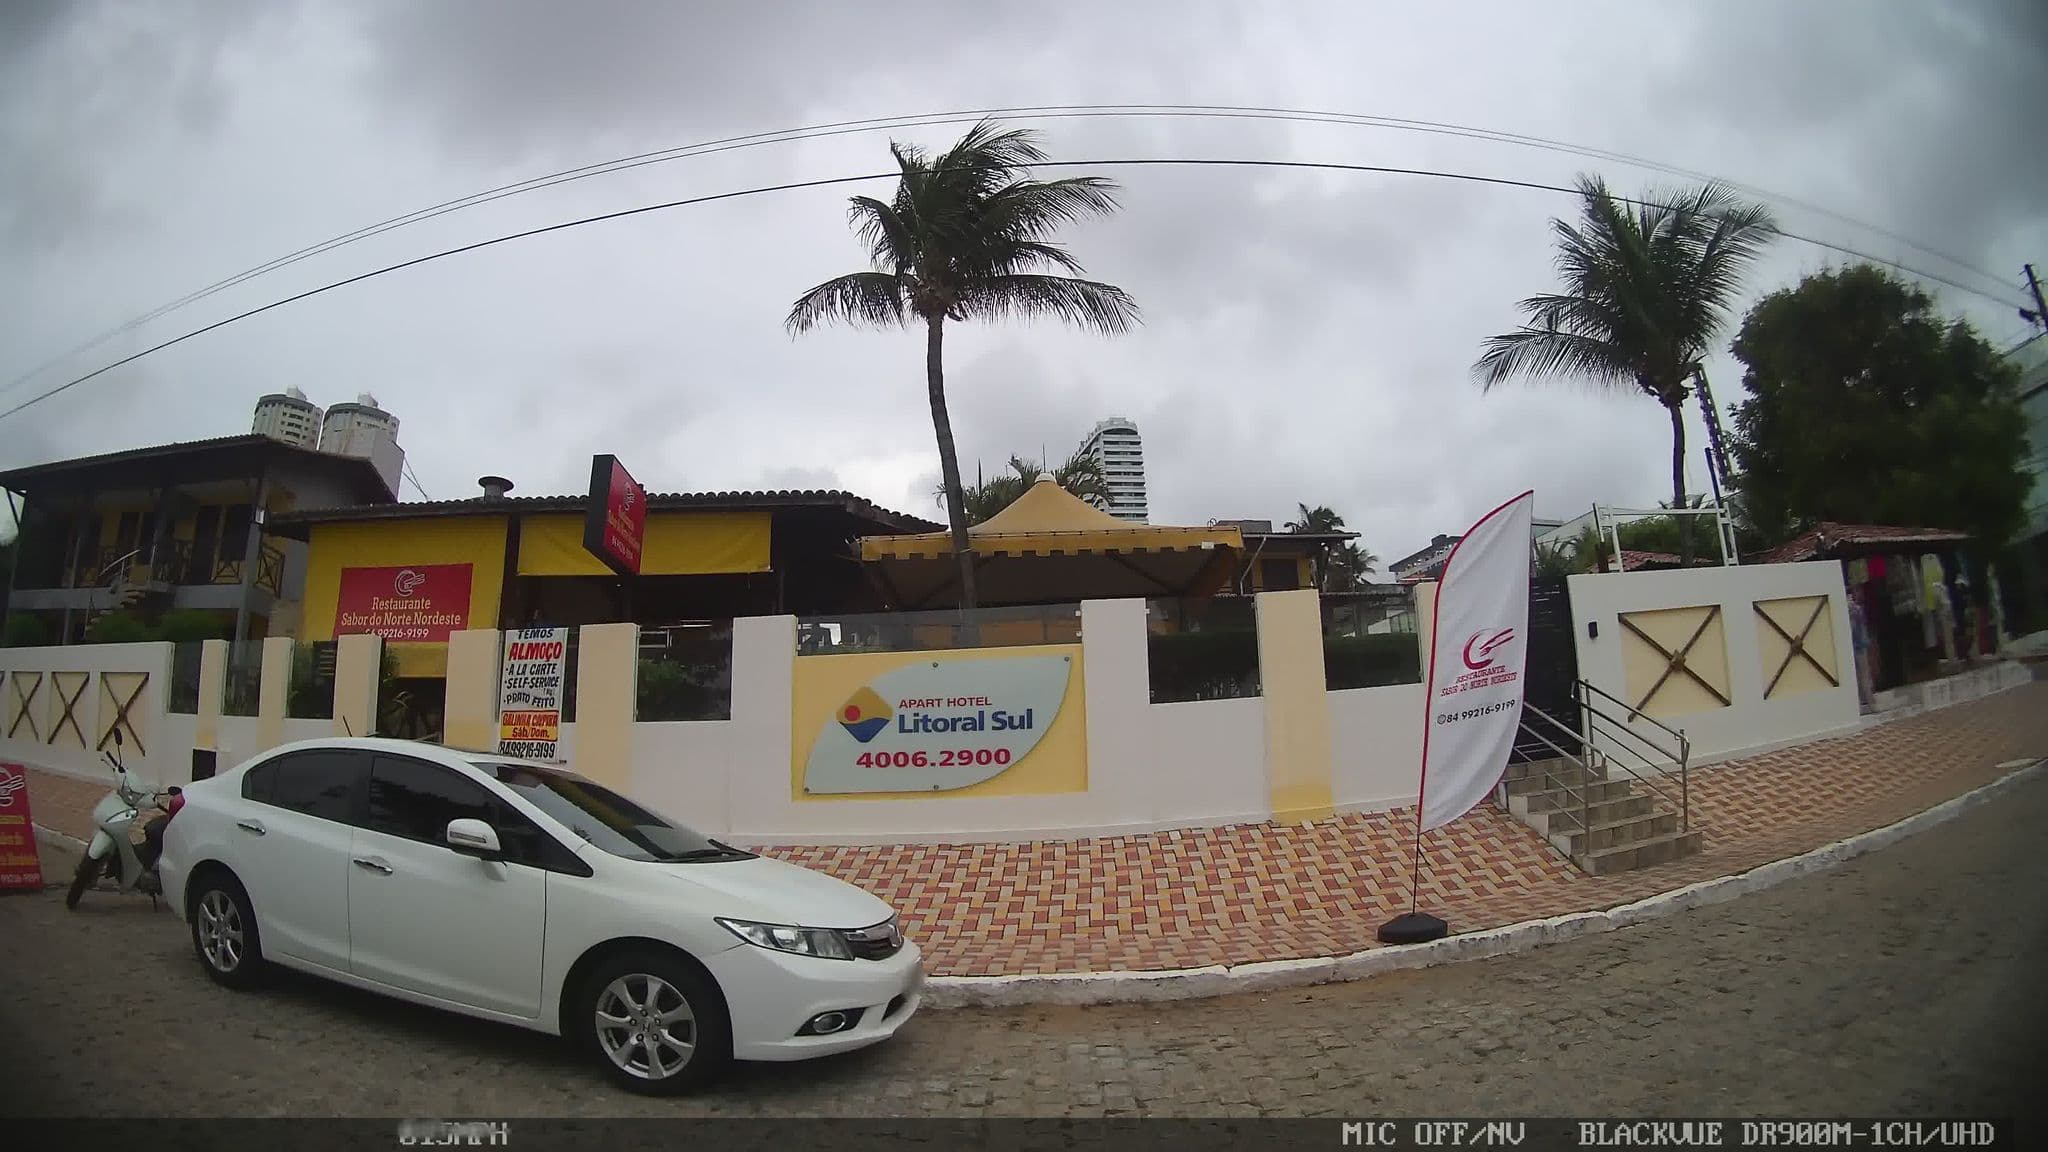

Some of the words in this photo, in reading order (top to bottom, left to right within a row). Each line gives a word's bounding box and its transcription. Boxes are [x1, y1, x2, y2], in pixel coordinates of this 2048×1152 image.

[371, 596, 431, 610] Restaurante
[341, 612, 368, 626] Sabor
[369, 612, 382, 626] do
[383, 611, 412, 626] Norte
[412, 610, 461, 625] Nordeste
[377, 628, 430, 639] 99216-9199
[517, 628, 554, 640] TEMOS
[508, 641, 563, 663] ALMOÇO
[516, 663, 528, 676] LA
[529, 662, 558, 676] CARTE
[506, 691, 531, 705] PRATO
[898, 698, 943, 709] APART
[946, 696, 993, 708] HOTEL
[1446, 712, 1459, 723] 84
[1461, 699, 1516, 719] 99216-9199
[898, 710, 985, 734] Litoral
[990, 708, 1033, 731] Sul
[856, 748, 1011, 768] 4006.2900
